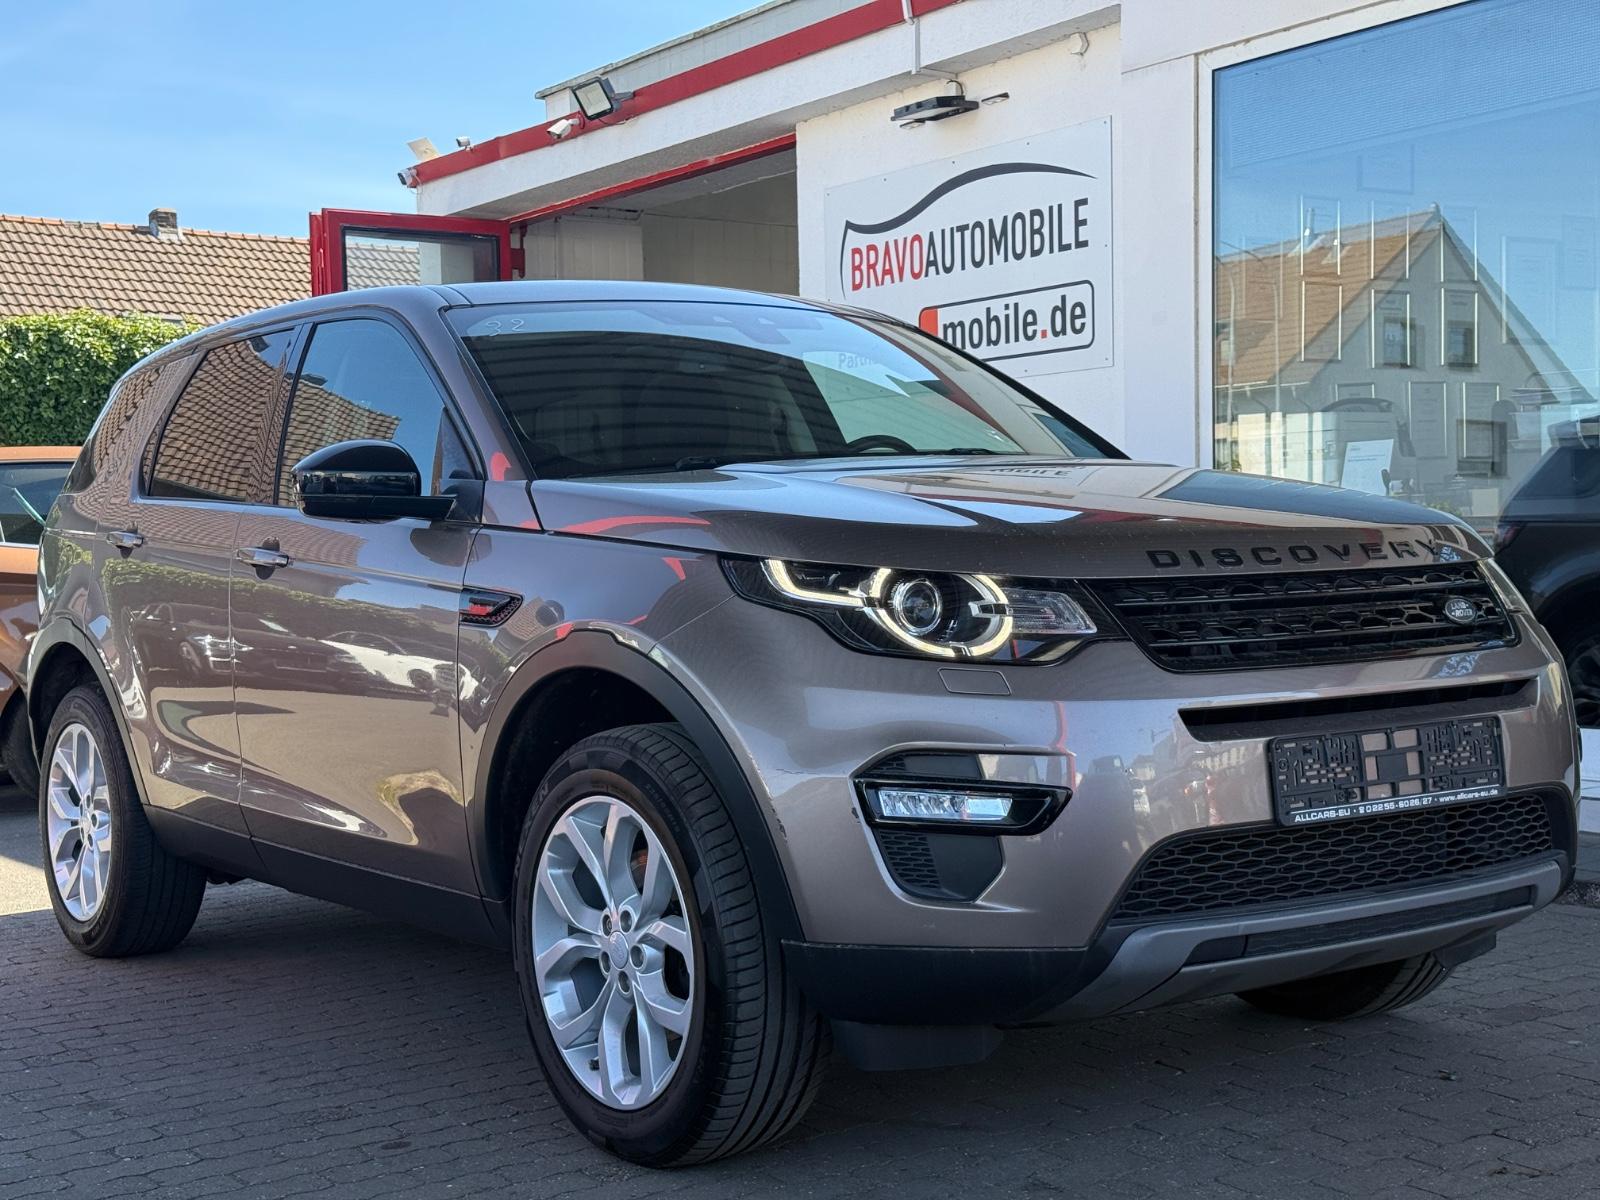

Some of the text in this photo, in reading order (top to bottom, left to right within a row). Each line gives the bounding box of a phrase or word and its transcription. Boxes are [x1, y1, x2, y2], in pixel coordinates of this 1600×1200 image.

[943, 294, 1087, 350] mobile.de
[1147, 539, 1437, 569] DISCOVERY
[1294, 807, 1351, 823] ALLCARS-EU
